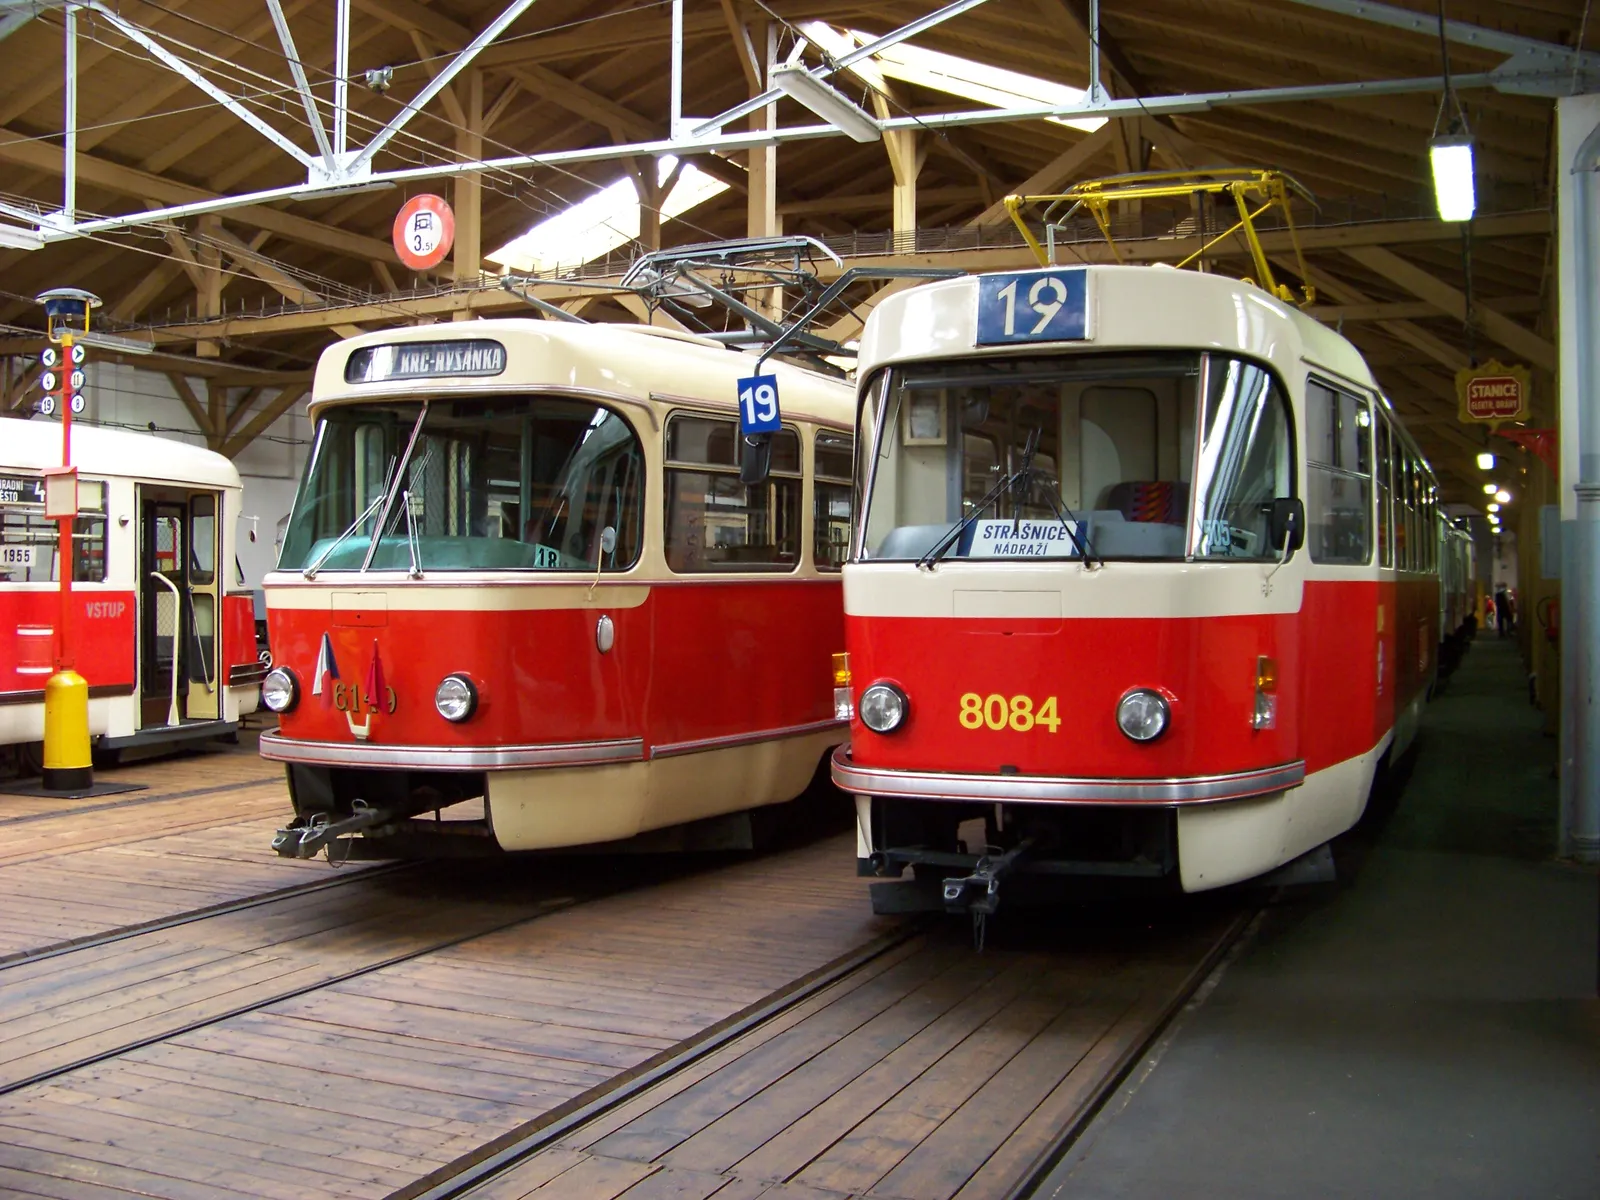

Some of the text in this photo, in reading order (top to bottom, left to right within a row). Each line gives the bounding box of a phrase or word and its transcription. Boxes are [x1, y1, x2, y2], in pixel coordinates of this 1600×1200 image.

[998, 277, 1067, 336] 19
[1471, 384, 1517, 398] STANICE
[740, 384, 777, 424] 19
[983, 523, 1067, 541] STRAŠNICE
[3, 549, 30, 562] 1955
[993, 541, 1049, 556] NÁDRAŽÍ
[86, 602, 125, 618] VSTUP
[959, 692, 1062, 733] 8084
